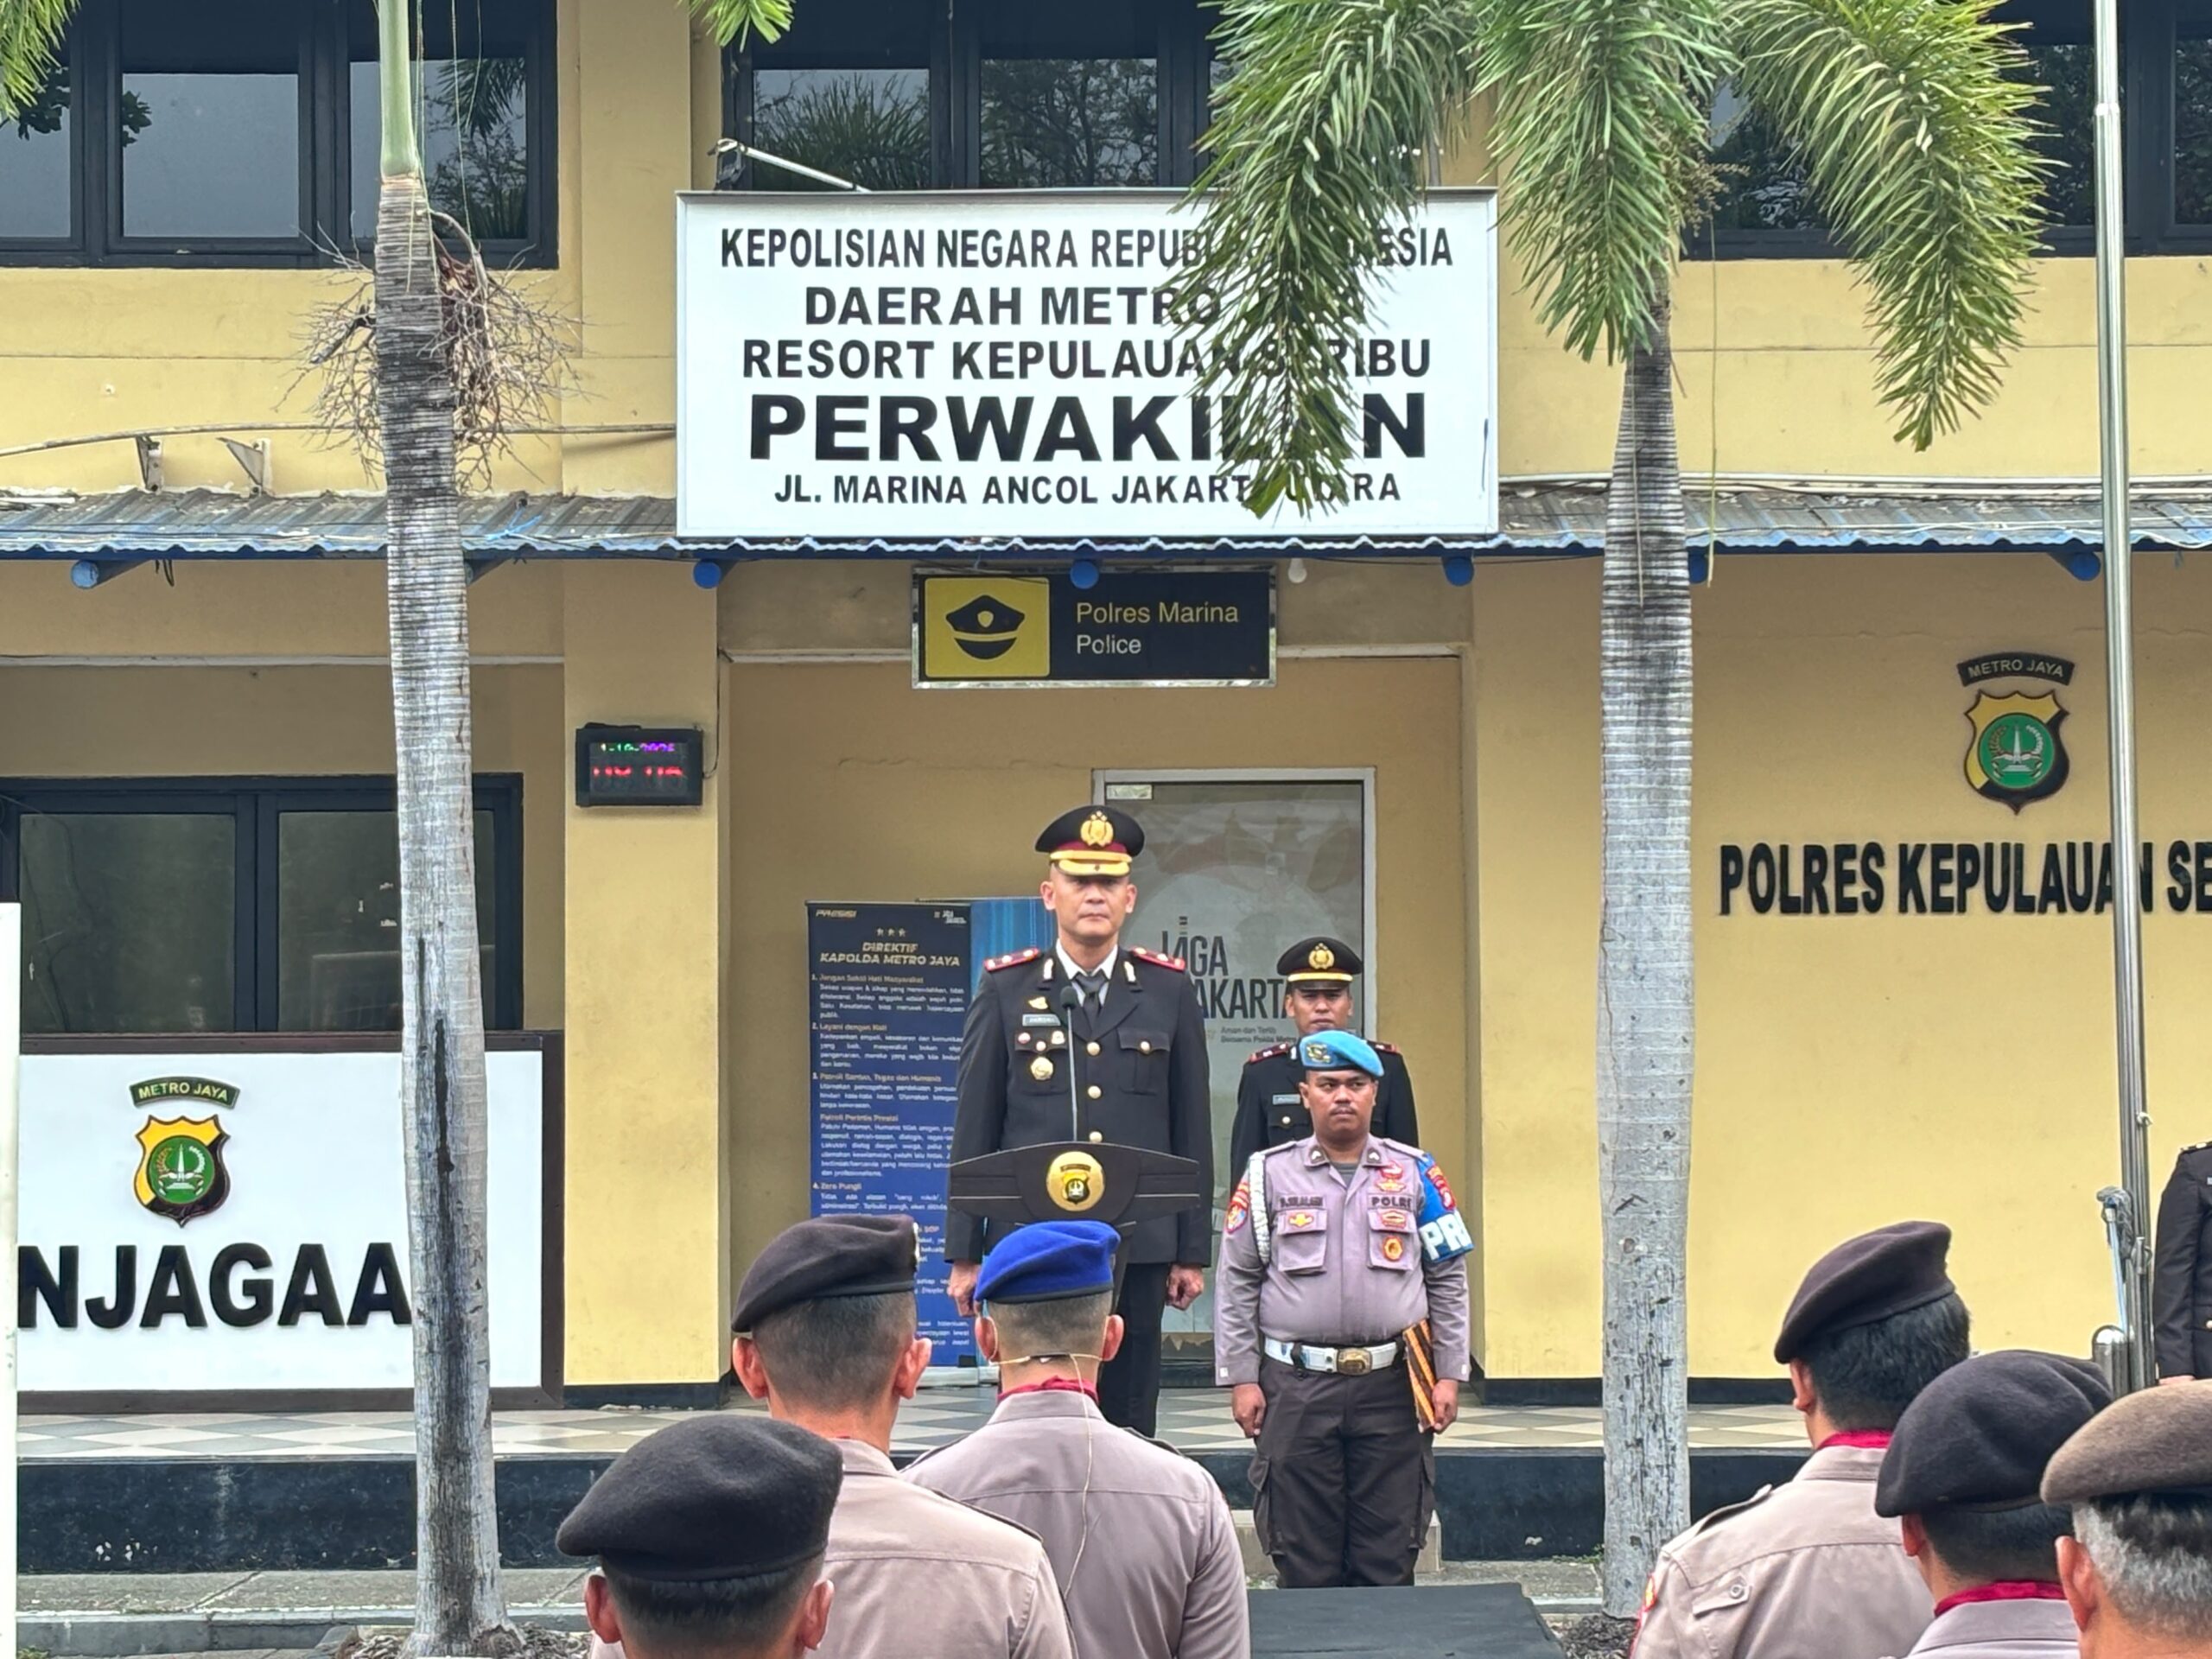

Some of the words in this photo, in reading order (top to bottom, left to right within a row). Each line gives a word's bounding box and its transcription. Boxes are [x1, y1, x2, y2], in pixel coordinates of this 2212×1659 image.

[722, 229, 924, 267] KEPOLISIAN
[938, 230, 1077, 268] NEGARA
[1091, 228, 1236, 268] REPUB
[806, 287, 1020, 325] DAERAH
[1040, 286, 1220, 325] METRO
[744, 340, 934, 378] RESORT
[749, 392, 1426, 461] PERWAKILN
[775, 475, 821, 502] JL.
[835, 476, 966, 503] MARINA
[983, 476, 1097, 504] ANCOL
[1111, 474, 1257, 504] JAKART
[1077, 603, 1151, 624] Polres
[1159, 601, 1239, 623] Marina
[1077, 635, 1141, 654] Police
[1967, 659, 2023, 679] METRO
[2026, 660, 2064, 677] JAYA
[1719, 842, 1885, 916] POLRES
[862, 942, 918, 953] DIREKTIF
[820, 953, 880, 963] KAPOLDA
[883, 954, 926, 965] METRO
[929, 956, 960, 966] JAYA
[819, 974, 845, 982] Jangan
[1196, 978, 1289, 1020] AKART
[819, 1022, 843, 1032] Layani
[845, 1024, 871, 1033] dengan
[138, 1082, 190, 1099] METRO
[194, 1083, 228, 1102] JAYA
[1372, 1197, 1412, 1208] POLRI
